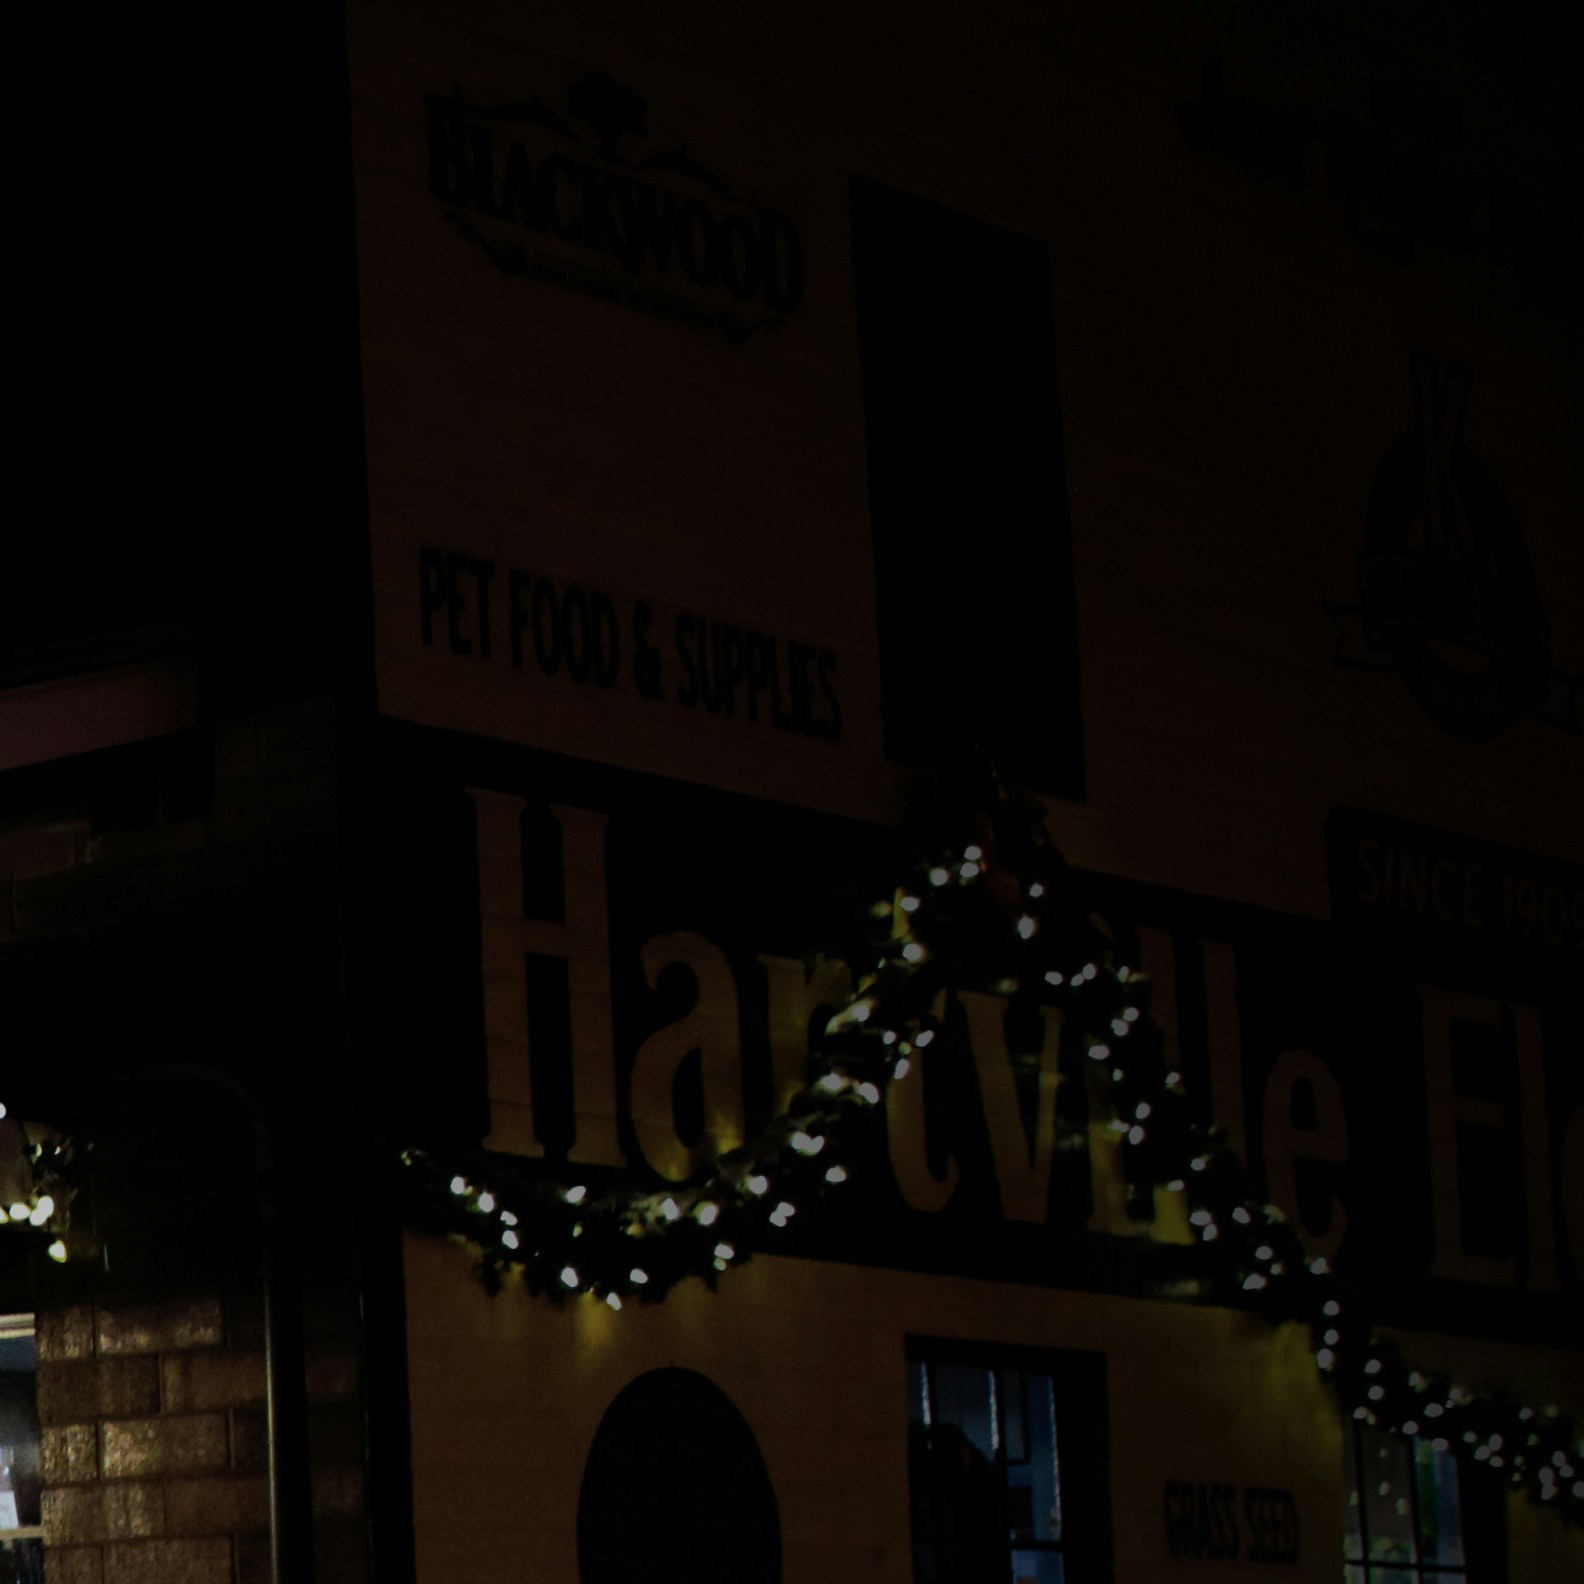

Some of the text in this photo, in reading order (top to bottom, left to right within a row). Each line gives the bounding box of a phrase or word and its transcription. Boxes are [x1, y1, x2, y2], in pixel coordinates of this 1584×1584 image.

[424, 91, 806, 313] BLACKWOOD
[419, 546, 843, 744] PET FOOD & SUPPLIES
[1356, 836, 1485, 929] SINCE
[1163, 1479, 1300, 1564] GRASS SEED
